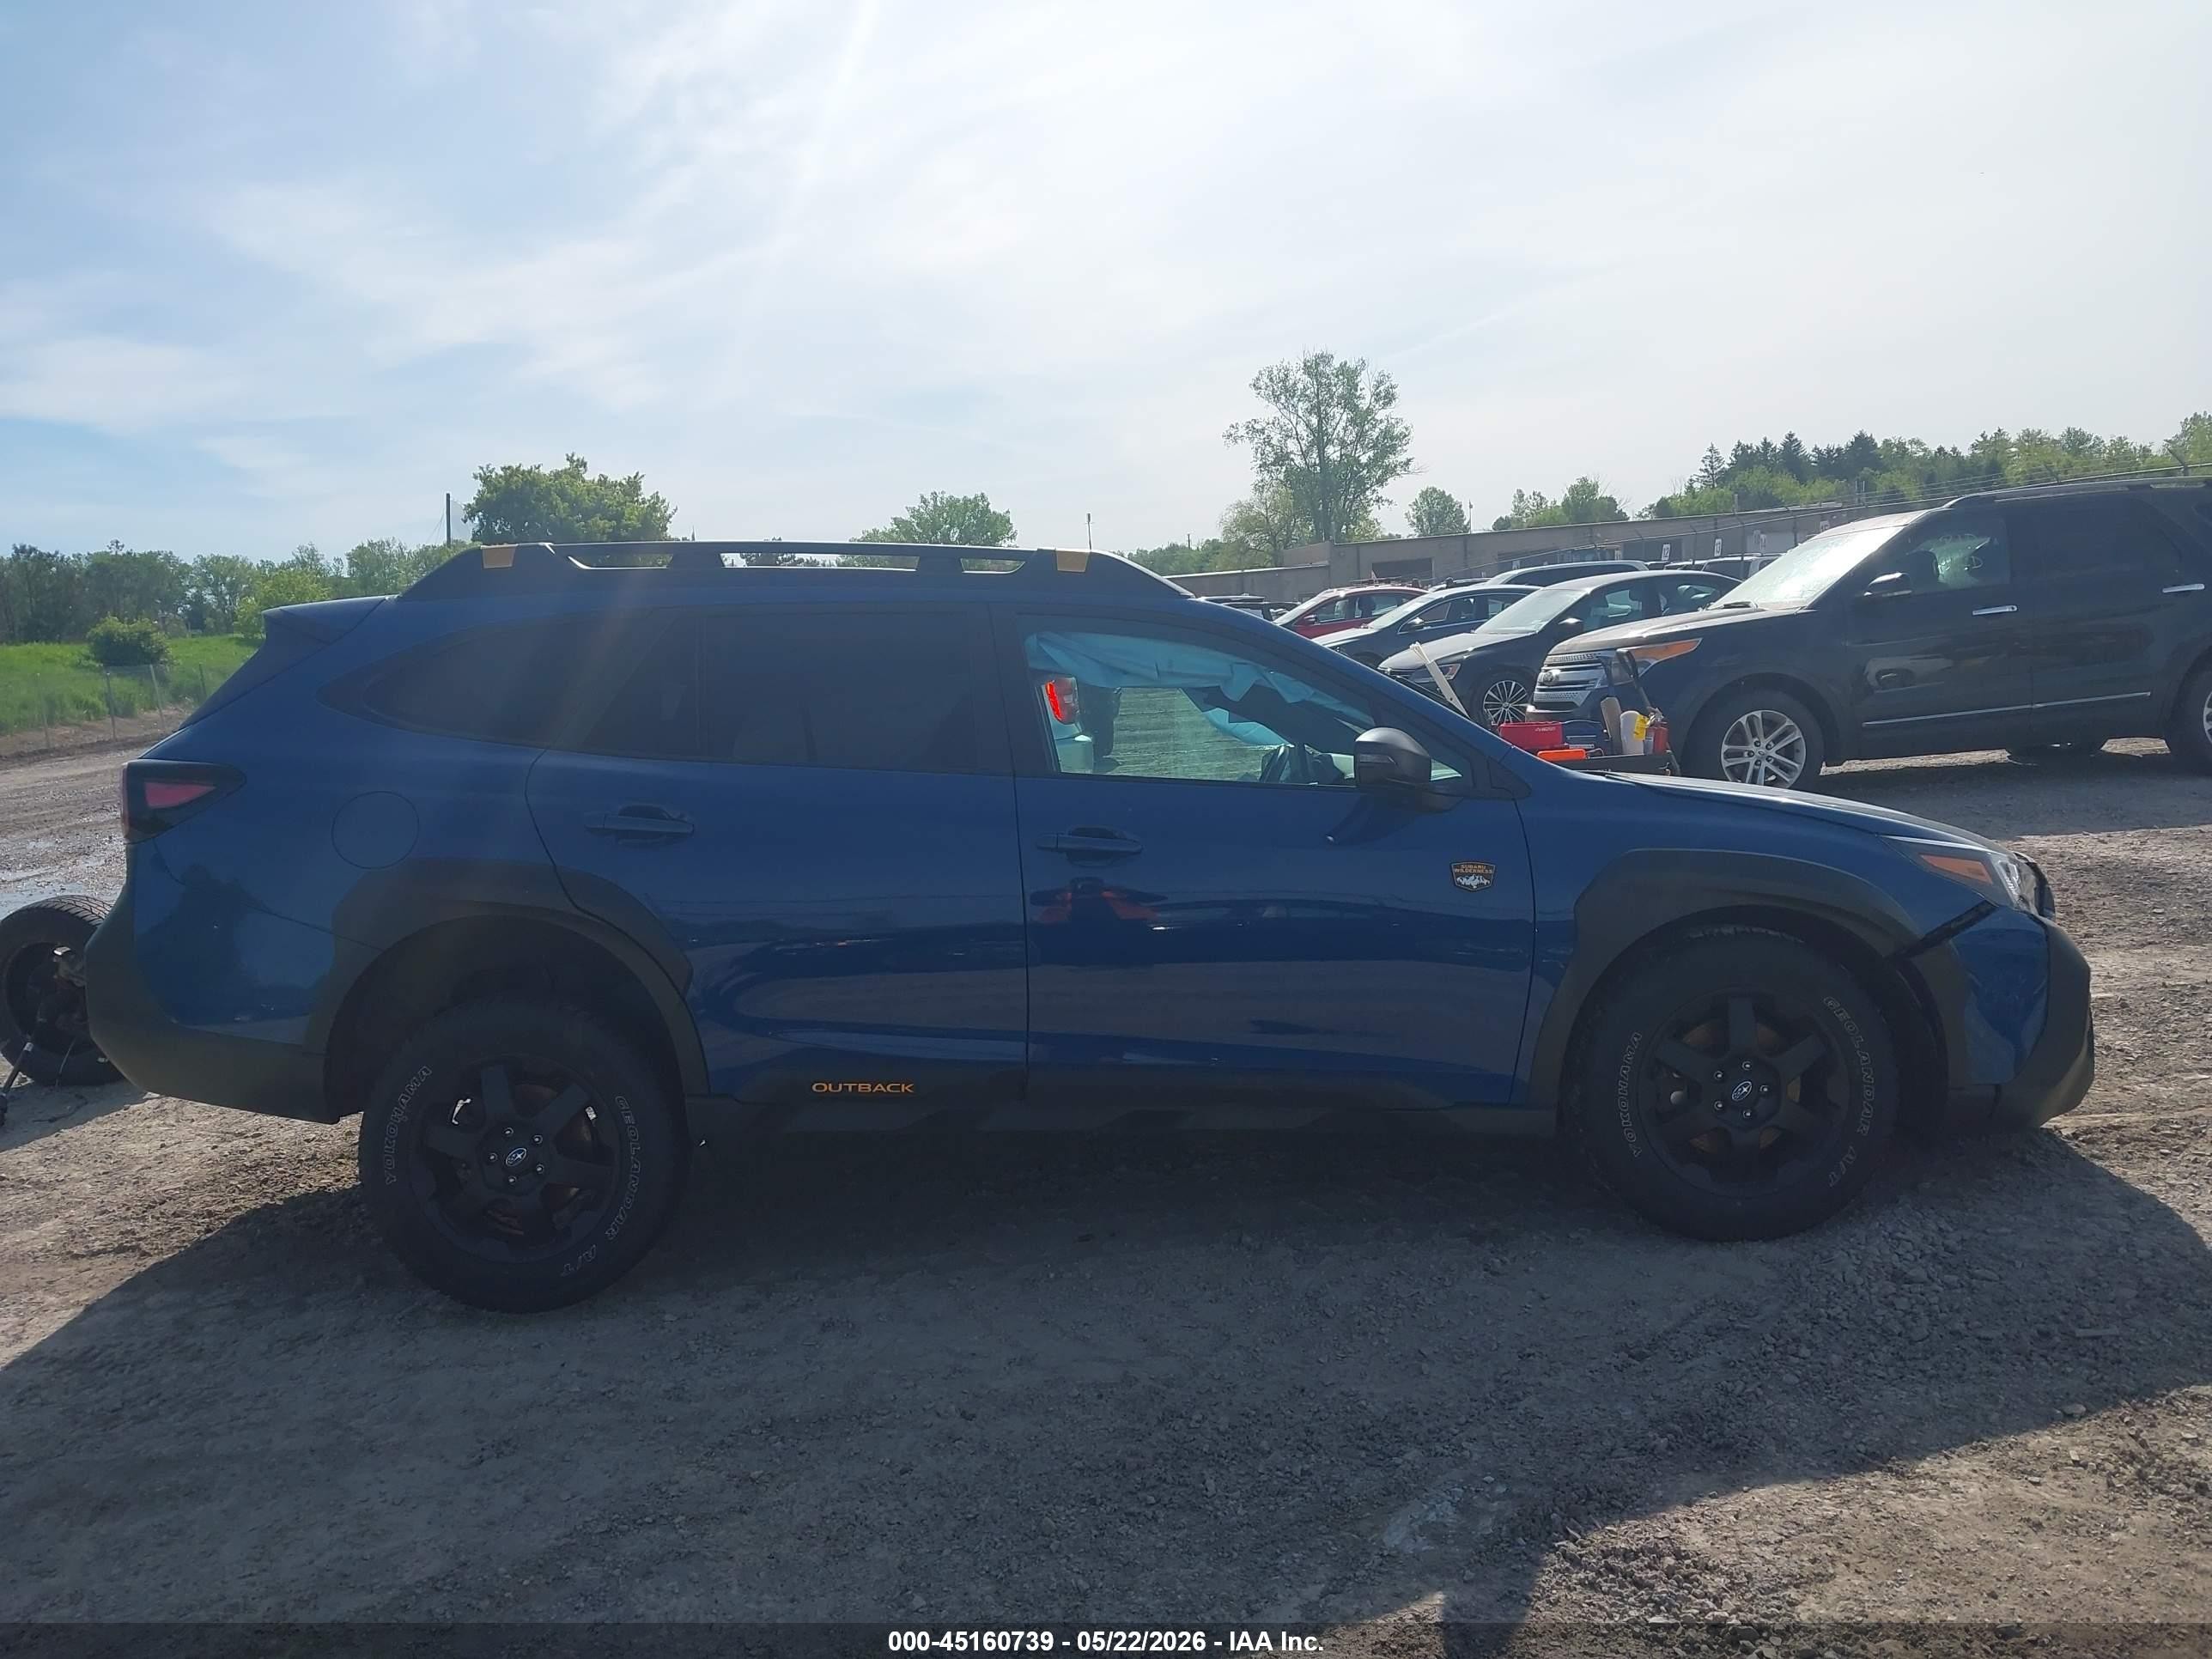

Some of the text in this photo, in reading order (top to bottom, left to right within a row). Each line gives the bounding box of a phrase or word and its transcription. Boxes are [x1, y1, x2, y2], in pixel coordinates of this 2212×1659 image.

[384, 1066, 432, 1185] YOKOHAMA
[811, 1082, 915, 1093] OUTBACK
[1618, 1031, 1642, 1158] YOKOHAMA
[1823, 996, 1875, 1136] GEOLANDAR
[605, 1096, 641, 1240] GEOLANDAR
